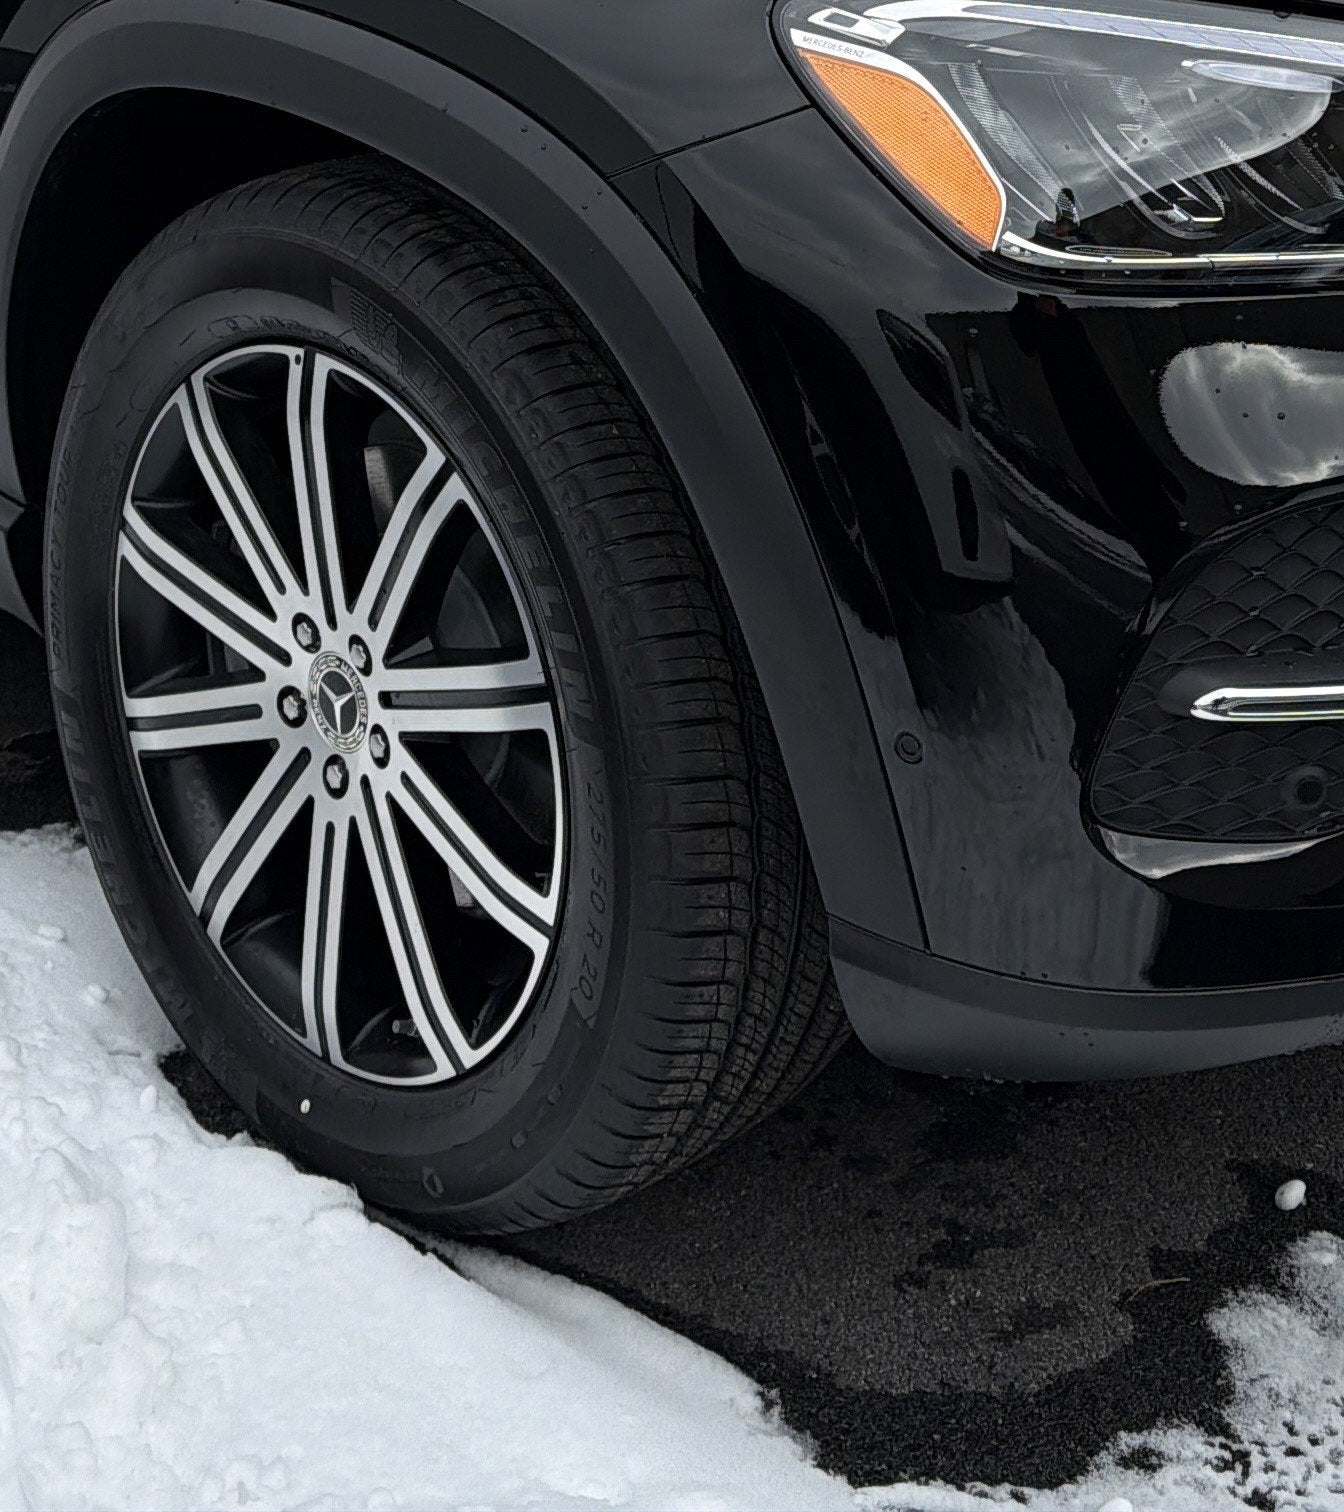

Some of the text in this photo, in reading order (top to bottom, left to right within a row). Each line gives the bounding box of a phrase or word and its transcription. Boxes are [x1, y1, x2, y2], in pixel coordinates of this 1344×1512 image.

[802, 34, 865, 59] MERCEDES-BENZ
[49, 446, 72, 661] PRIMACY TOUR
[408, 352, 598, 726] MICHELIN
[340, 659, 368, 726] MERCEDES
[586, 781, 608, 914] 275/50
